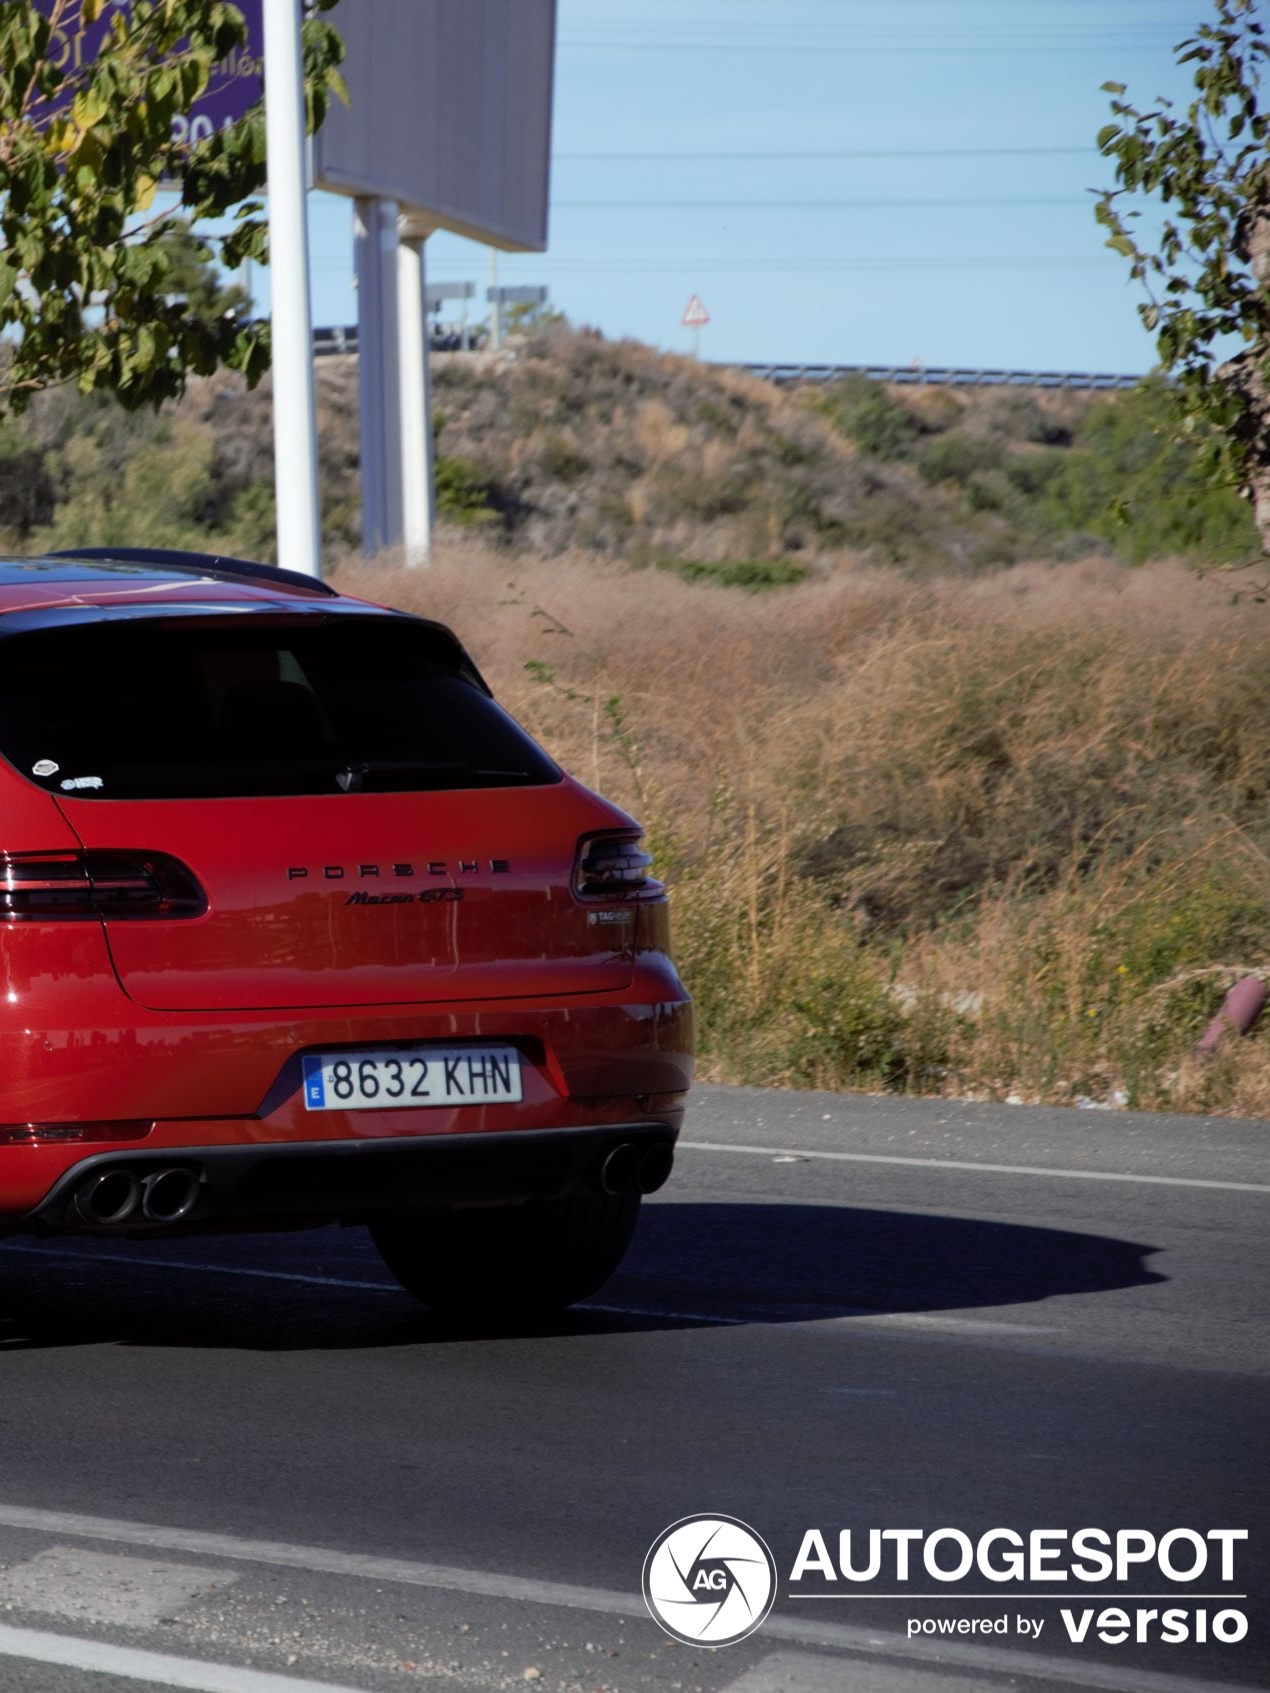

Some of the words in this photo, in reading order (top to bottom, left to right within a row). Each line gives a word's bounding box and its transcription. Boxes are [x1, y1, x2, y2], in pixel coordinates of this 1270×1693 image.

[286, 859, 511, 881] PORSCHE
[344, 891, 414, 906] Macan
[418, 887, 465, 902] GTS
[332, 1057, 430, 1100] 8632
[444, 1054, 512, 1096] KHN
[310, 1087, 320, 1099] E
